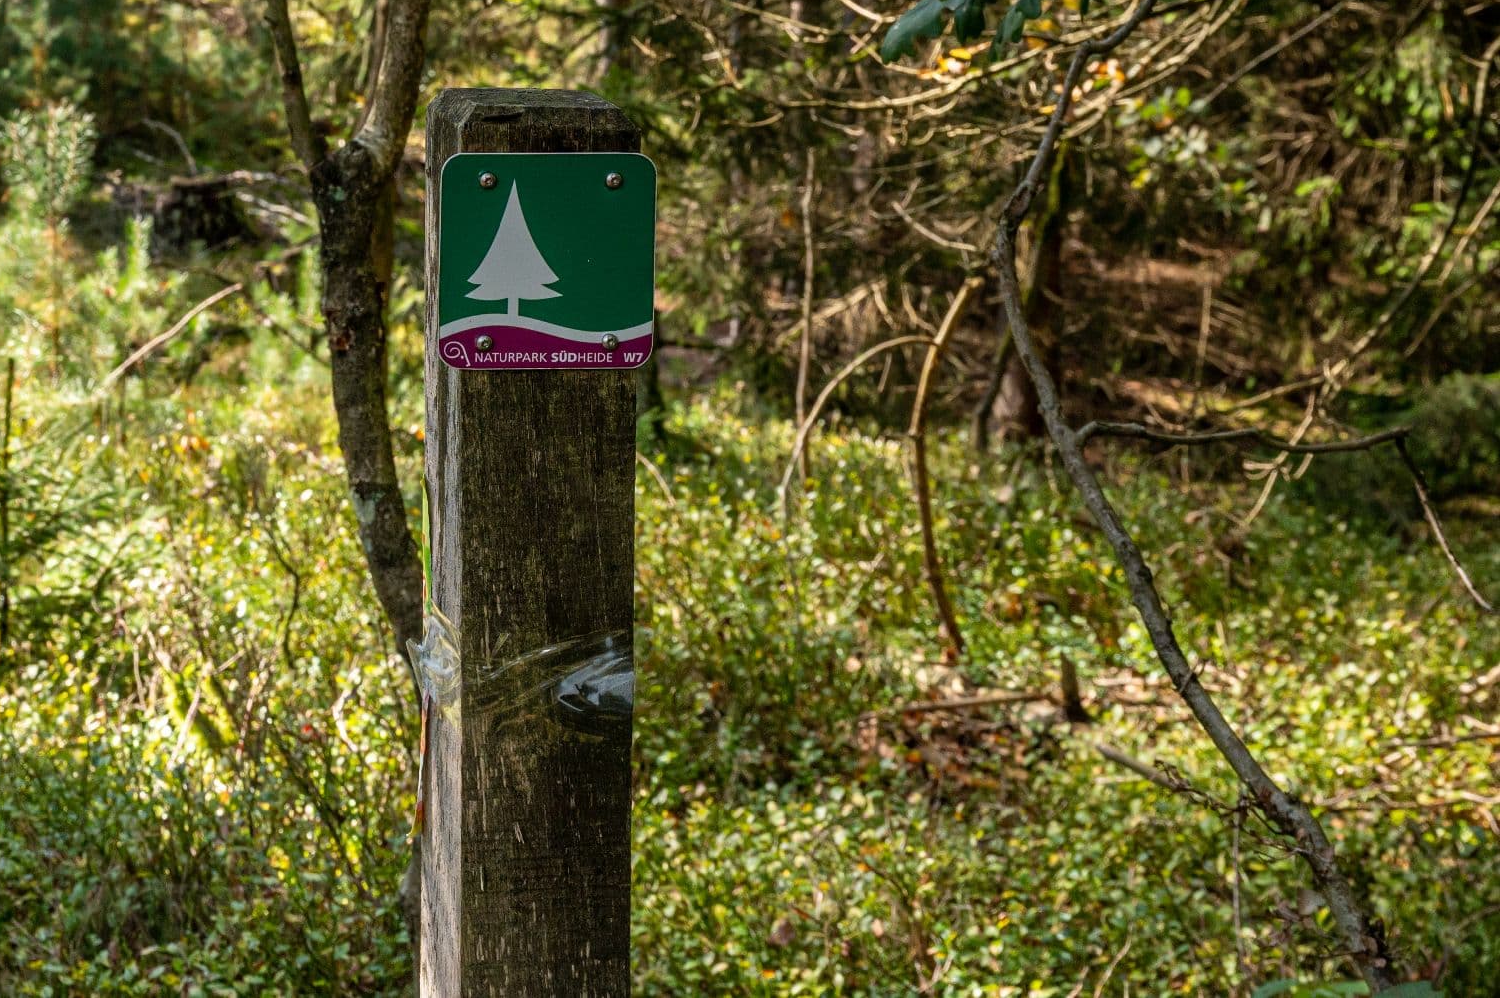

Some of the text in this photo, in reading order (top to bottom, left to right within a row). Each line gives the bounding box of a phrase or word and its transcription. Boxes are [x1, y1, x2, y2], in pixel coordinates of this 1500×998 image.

[474, 350, 644, 363] NATURPARK SÜDHEIDE W7
